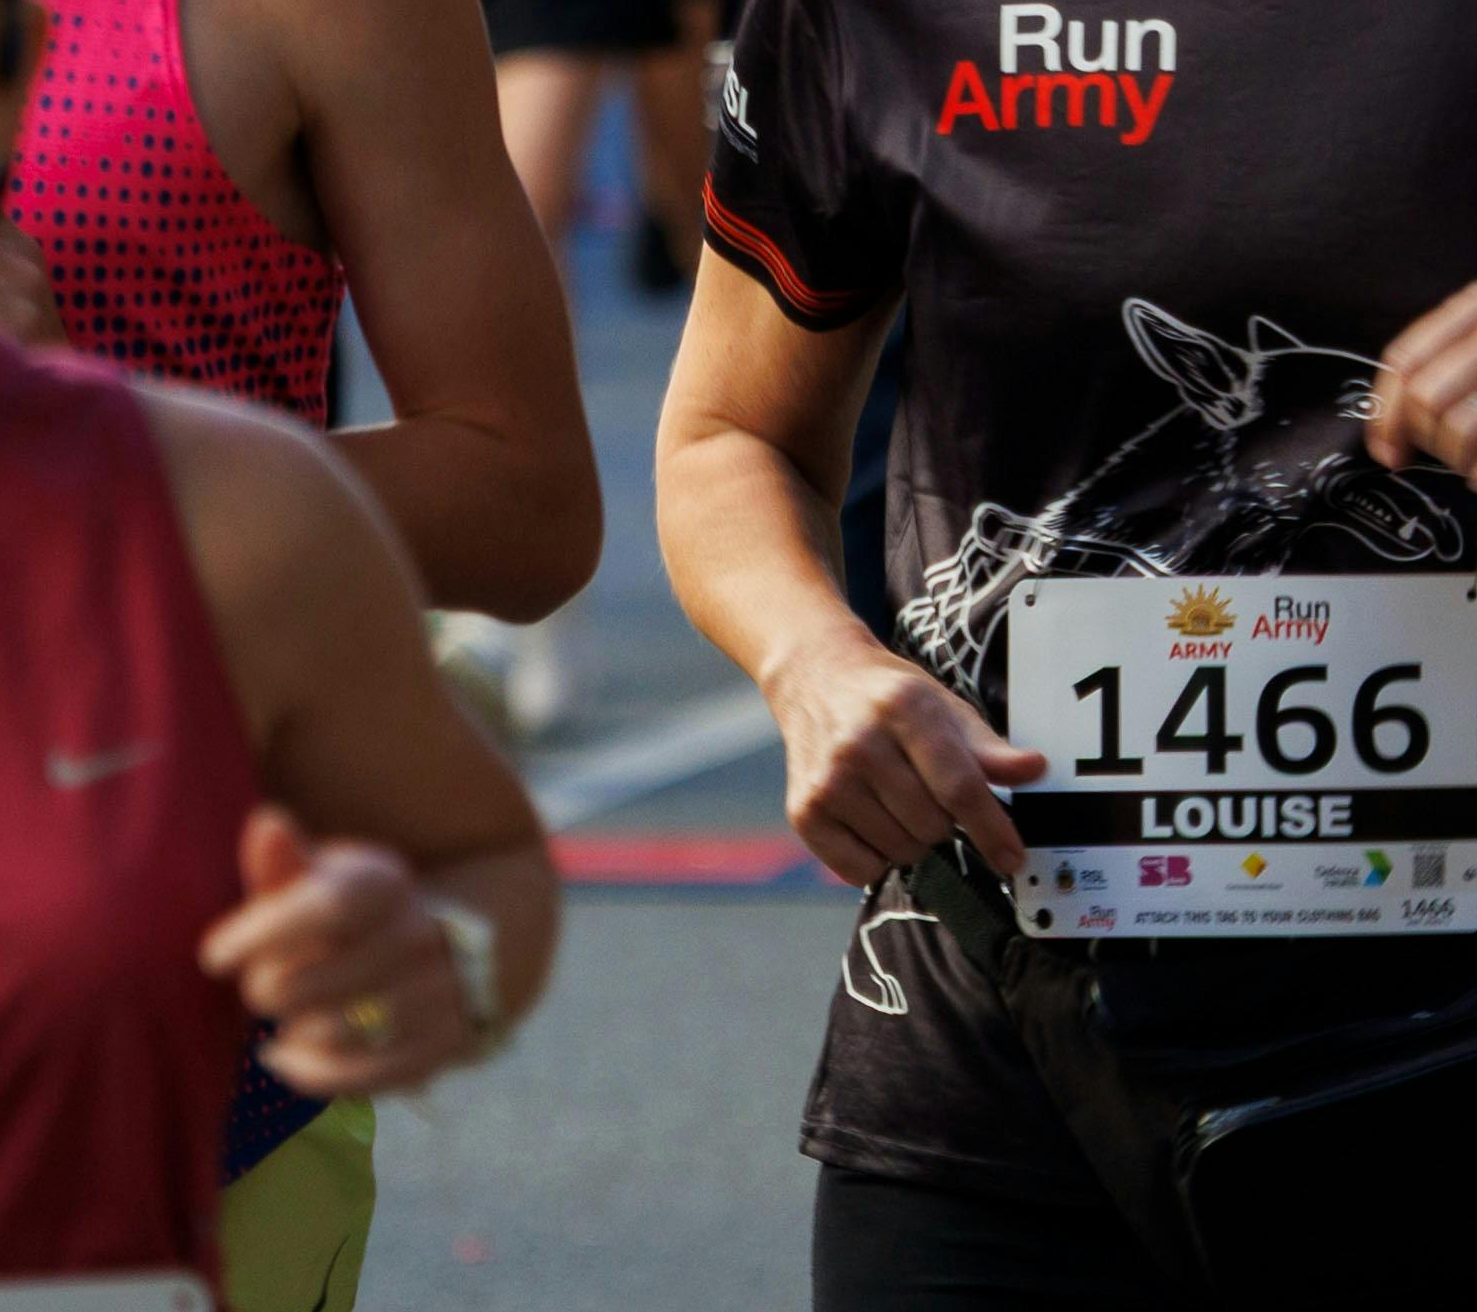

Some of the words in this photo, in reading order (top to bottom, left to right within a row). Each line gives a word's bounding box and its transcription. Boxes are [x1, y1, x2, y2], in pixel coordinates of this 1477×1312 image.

[998, 4, 1178, 74] Run
[936, 60, 1175, 145] Army
[1251, 614, 1330, 645] Army
[1274, 595, 1330, 621] Run
[1169, 641, 1233, 660] ARMY
[1072, 662, 1431, 777] 1466
[1141, 794, 1354, 839] LOUISE
